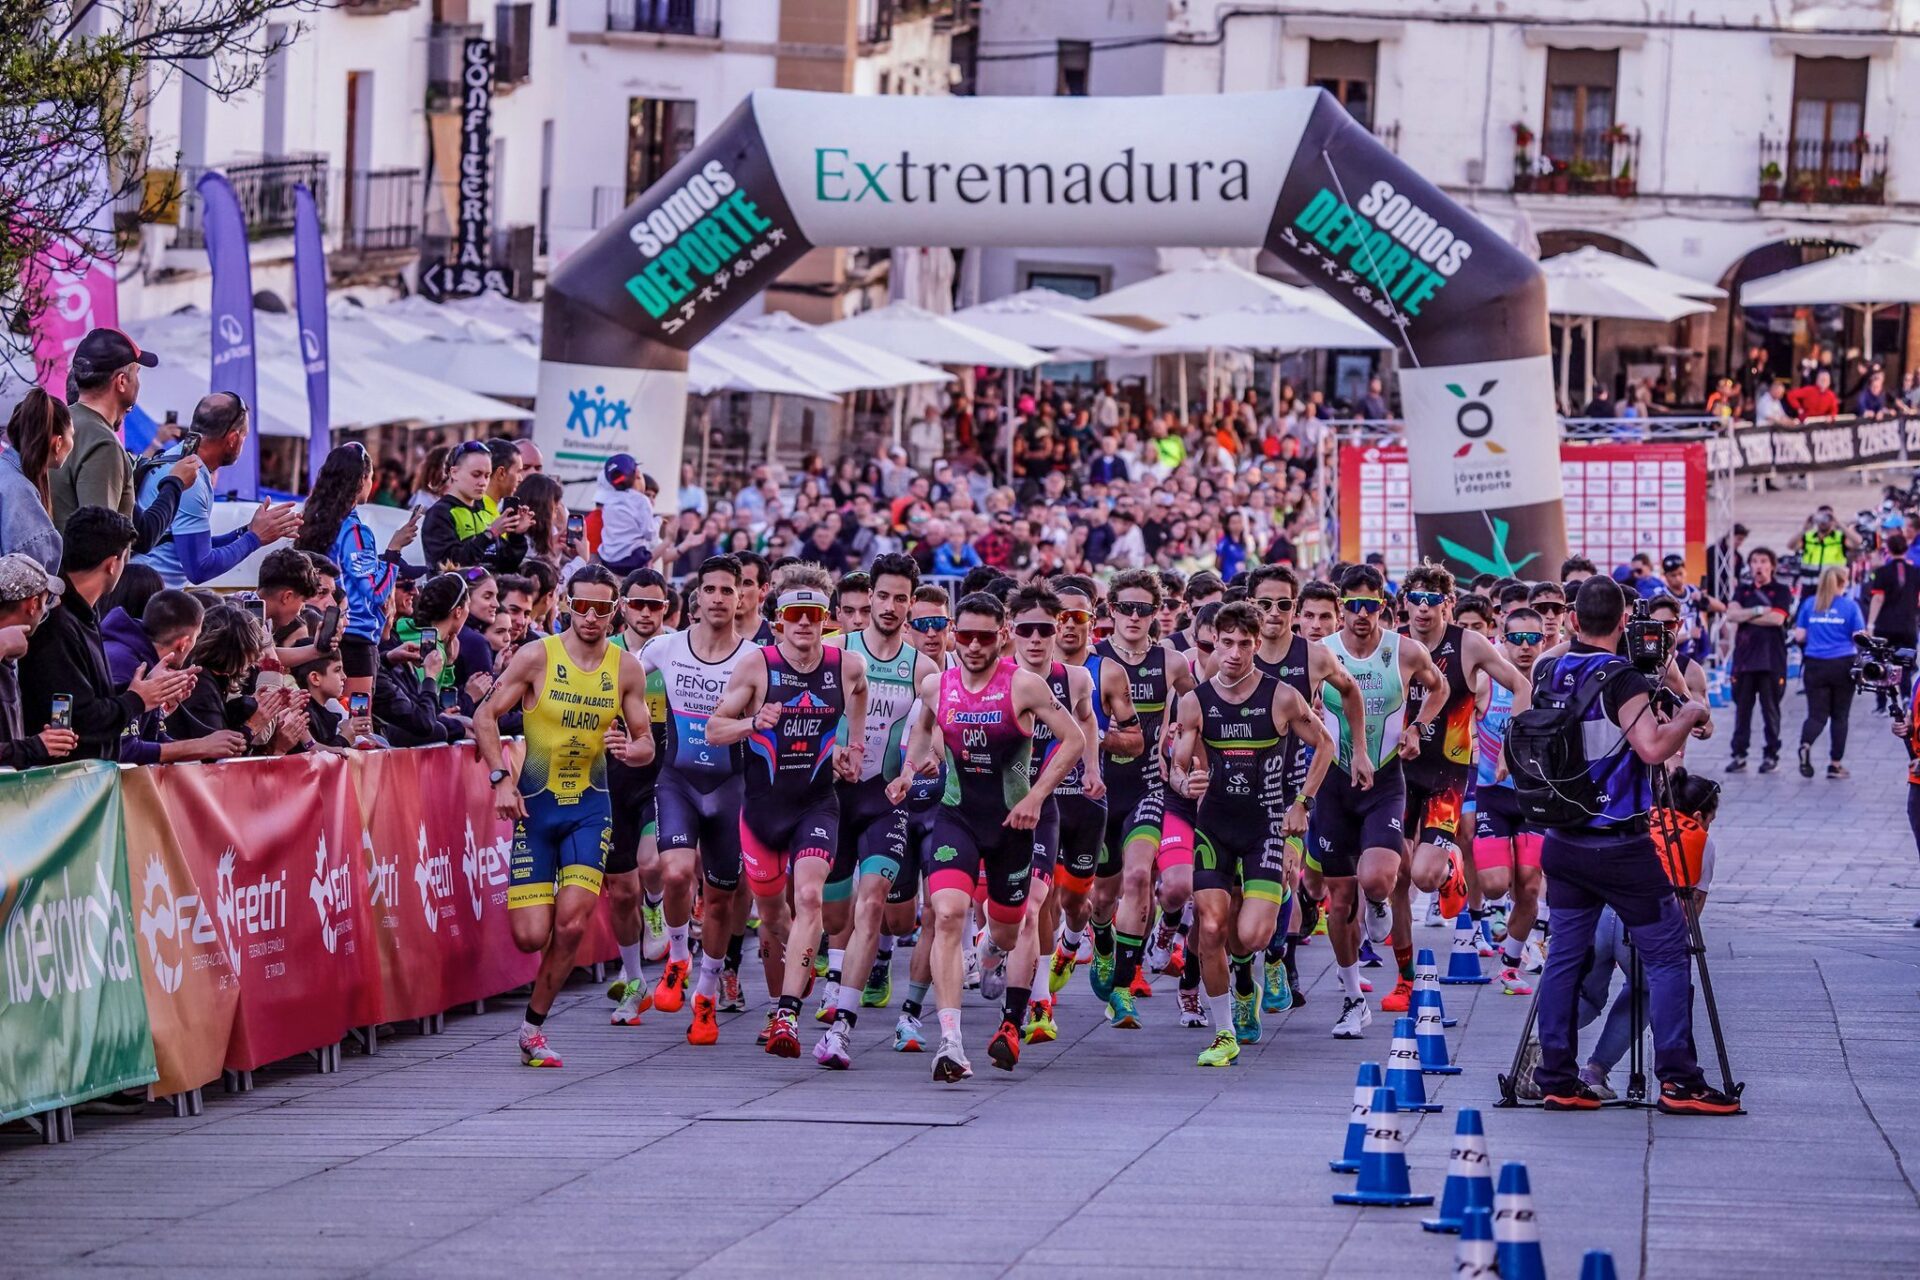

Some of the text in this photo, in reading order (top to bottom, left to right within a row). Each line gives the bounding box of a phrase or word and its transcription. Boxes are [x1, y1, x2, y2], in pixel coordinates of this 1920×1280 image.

[814, 147, 1251, 204] Extremadura
[629, 160, 736, 258] SOMOS
[1357, 180, 1473, 277] SOMOS
[624, 188, 772, 319] DEPORTE
[1294, 187, 1448, 316] DEPORTE
[1454, 470, 1512, 486] jóvenes
[1464, 481, 1512, 493] deporte
[549, 689, 615, 709] TRIATLÓN ALBACETE
[675, 688, 704, 700] CLÍNICA
[561, 709, 600, 732] HILARIO
[784, 714, 822, 737] GÁLVEZ
[955, 711, 1002, 724] SALTOKI
[963, 726, 987, 748] CAPÓ
[1220, 723, 1252, 738] MARTIN
[1226, 786, 1251, 794] GEO
[672, 833, 688, 844] psi
[235, 870, 286, 937] fetri
[510, 893, 538, 902] TRIATLÓN
[5, 861, 133, 1004] iberdrola
